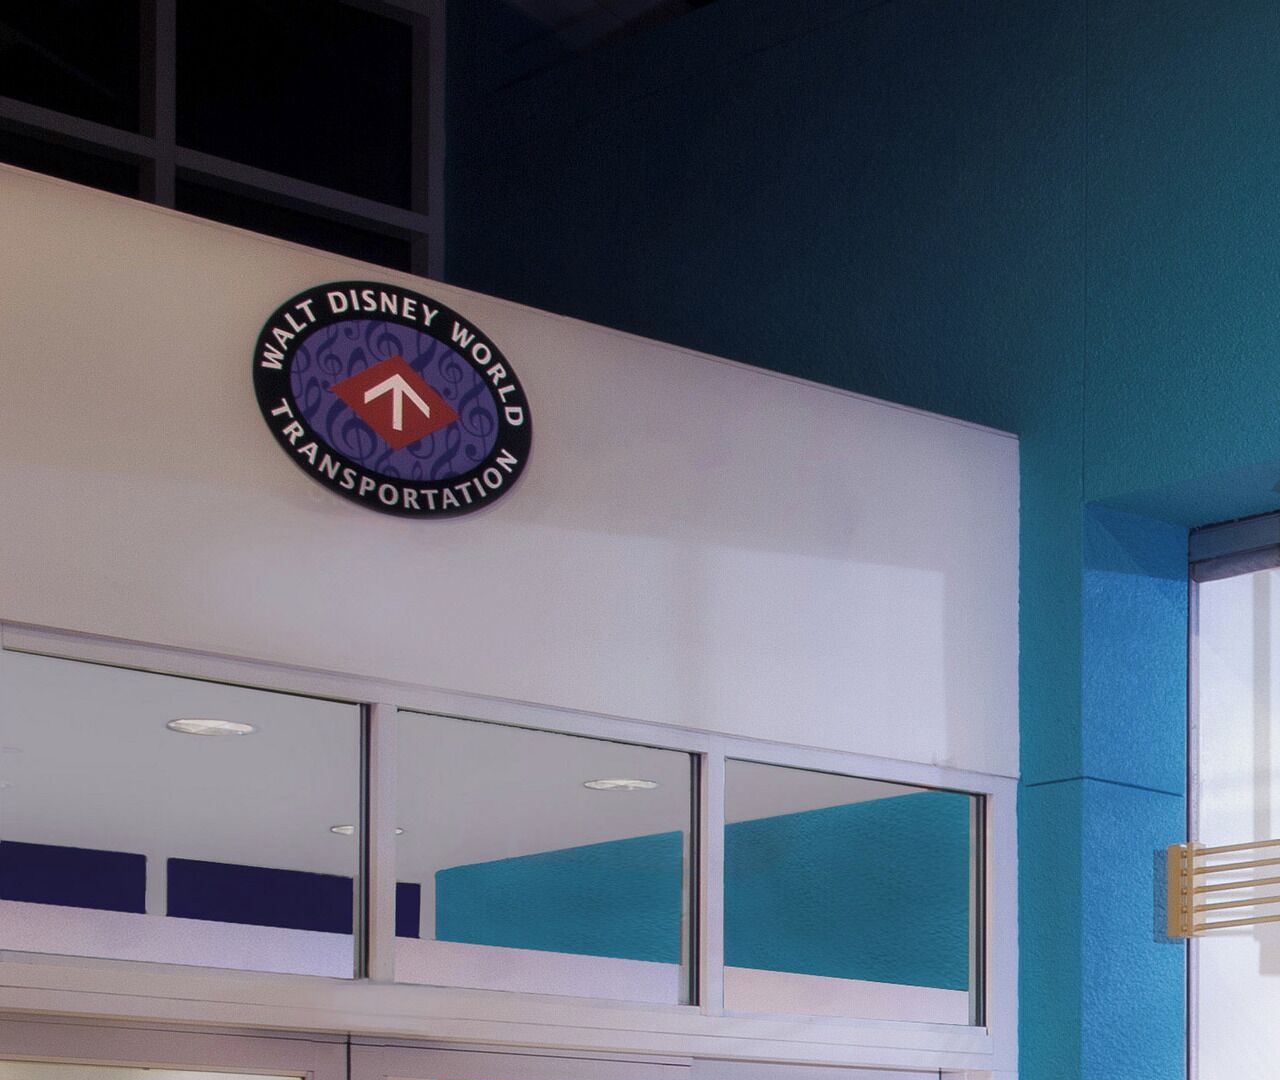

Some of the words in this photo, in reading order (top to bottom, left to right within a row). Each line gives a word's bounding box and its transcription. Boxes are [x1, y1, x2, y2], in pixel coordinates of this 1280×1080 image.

[261, 299, 317, 371] WALT
[327, 288, 439, 327] DISNEY
[450, 321, 524, 427] WORLD
[271, 397, 519, 511] TRANSPORTATION
